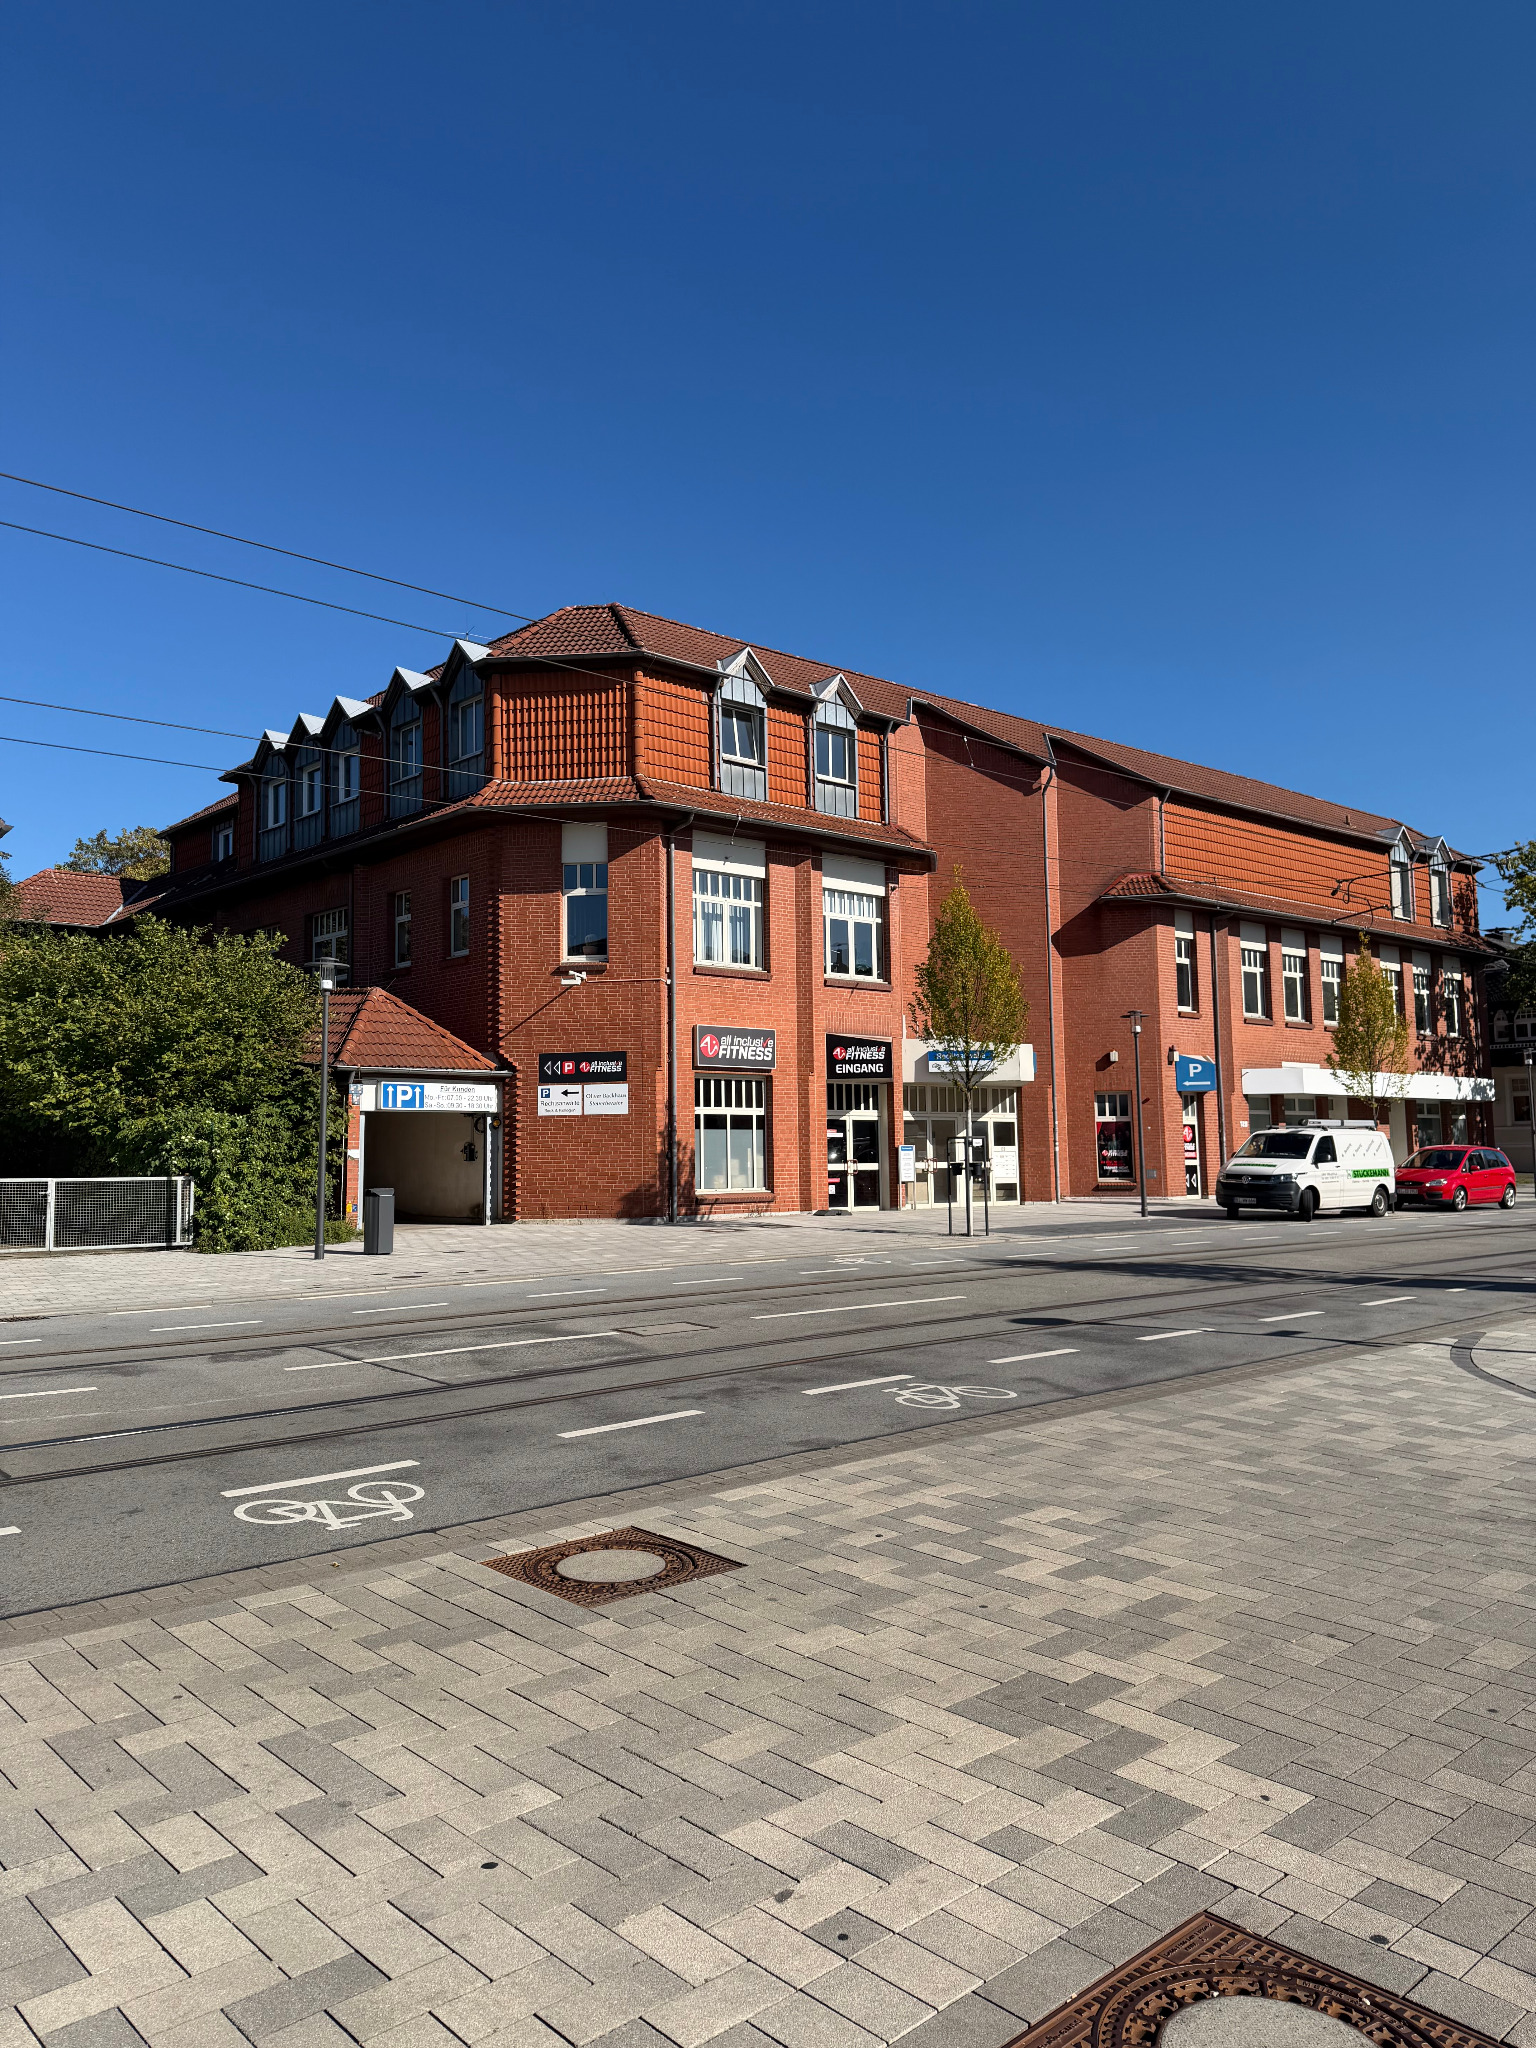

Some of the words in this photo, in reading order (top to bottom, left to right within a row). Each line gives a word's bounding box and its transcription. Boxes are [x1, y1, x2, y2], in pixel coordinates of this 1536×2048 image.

[720, 1035, 732, 1046] all
[733, 1036, 774, 1048] inclusive
[718, 1046, 773, 1060] FITNESS
[846, 1052, 885, 1060] FITNESS
[564, 1062, 573, 1072] P
[590, 1065, 622, 1073] FITNESS
[835, 1063, 884, 1074] EINGANG
[1189, 1063, 1202, 1077] P
[396, 1085, 413, 1108] P
[542, 1089, 550, 1097] P
